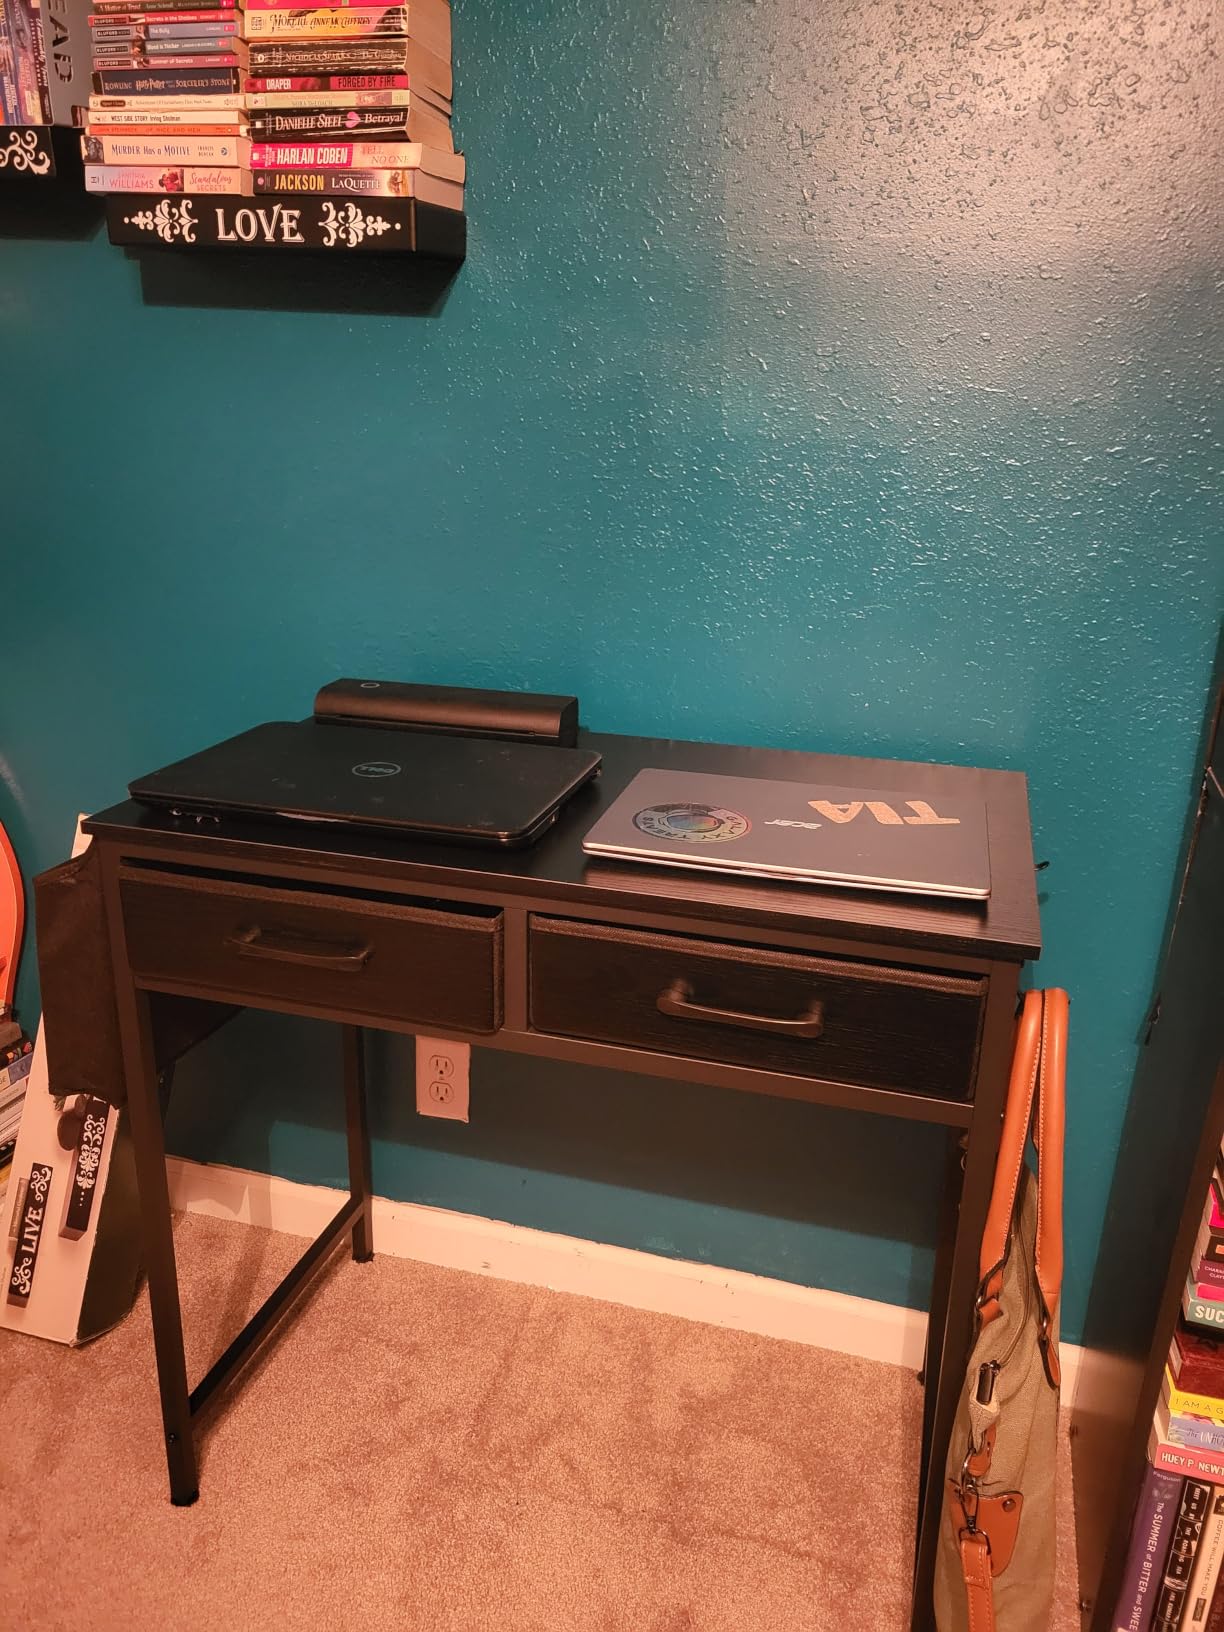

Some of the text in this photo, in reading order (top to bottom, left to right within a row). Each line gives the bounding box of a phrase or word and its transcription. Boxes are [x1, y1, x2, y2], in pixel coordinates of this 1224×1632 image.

[266, 79, 291, 90] DRAPER
[338, 76, 396, 88] FORGED BY FIRE
[275, 115, 316, 131] DANIELLE
[317, 113, 342, 129] STEEL
[365, 112, 404, 125] Betrayal
[111, 144, 141, 156] MURDER
[143, 145, 156, 155] Has
[164, 144, 190, 156] MOTIVE
[276, 147, 314, 164] HARLAN
[316, 147, 348, 164] COBEN
[372, 155, 387, 164] NO
[109, 178, 154, 189] WILLIAMS
[190, 172, 232, 185] Scandalous
[274, 174, 325, 191] JACKSON
[215, 203, 305, 242] LOVE
[764, 819, 822, 830] acer
[21, 1206, 43, 1254] LIVE
[1195, 1305, 1224, 1323] SUC
[1183, 1401, 1200, 1409] AM
[1161, 1452, 1185, 1467] HUEY
[1187, 1459, 1194, 1467] P
[1153, 1471, 1182, 1482] Ferguson
[1156, 1502, 1164, 1513] The
[1147, 1513, 1163, 1552] SUMMER
[1214, 1519, 1224, 1545] COFFEE
[1138, 1561, 1152, 1593] BITTER
[1135, 1594, 1143, 1605] and
[1129, 1606, 1142, 1631] SWEE
